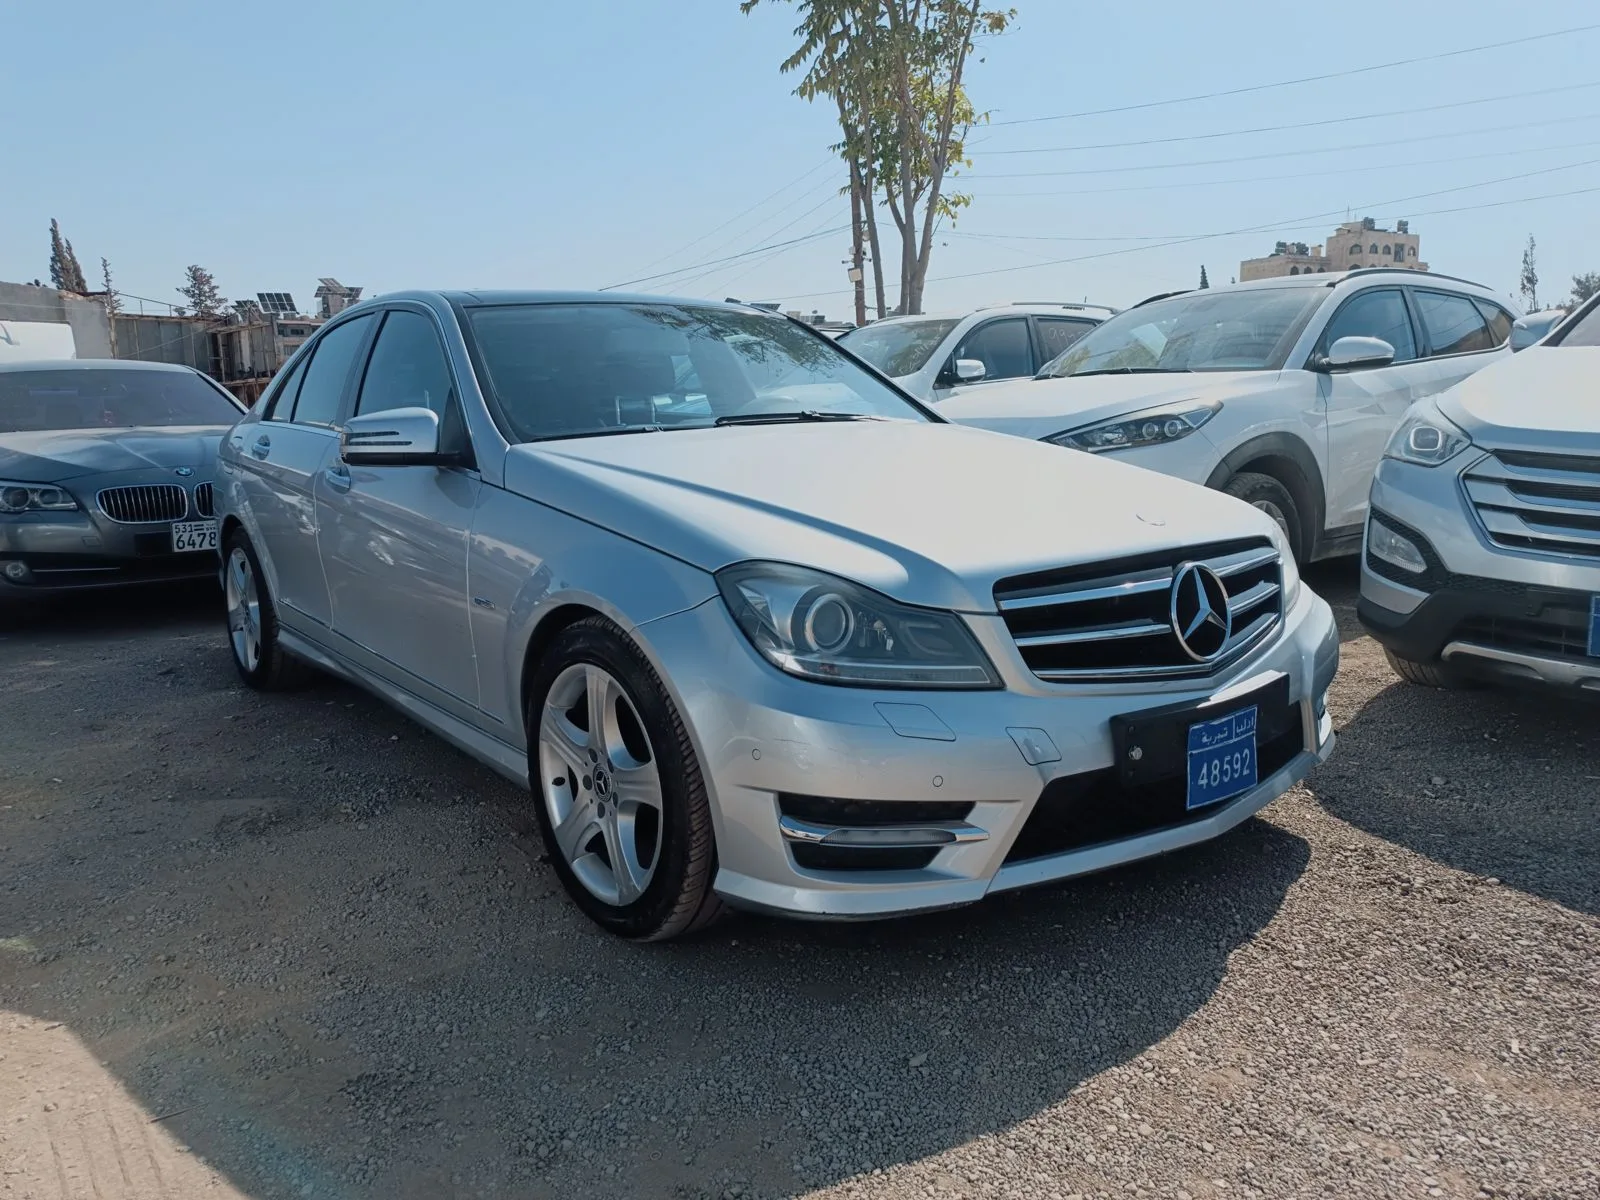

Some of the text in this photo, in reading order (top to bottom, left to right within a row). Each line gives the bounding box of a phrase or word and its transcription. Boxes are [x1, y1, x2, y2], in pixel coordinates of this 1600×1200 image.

[175, 524, 193, 534] 531
[176, 531, 216, 549] 6478
[1198, 748, 1250, 789] 48592
